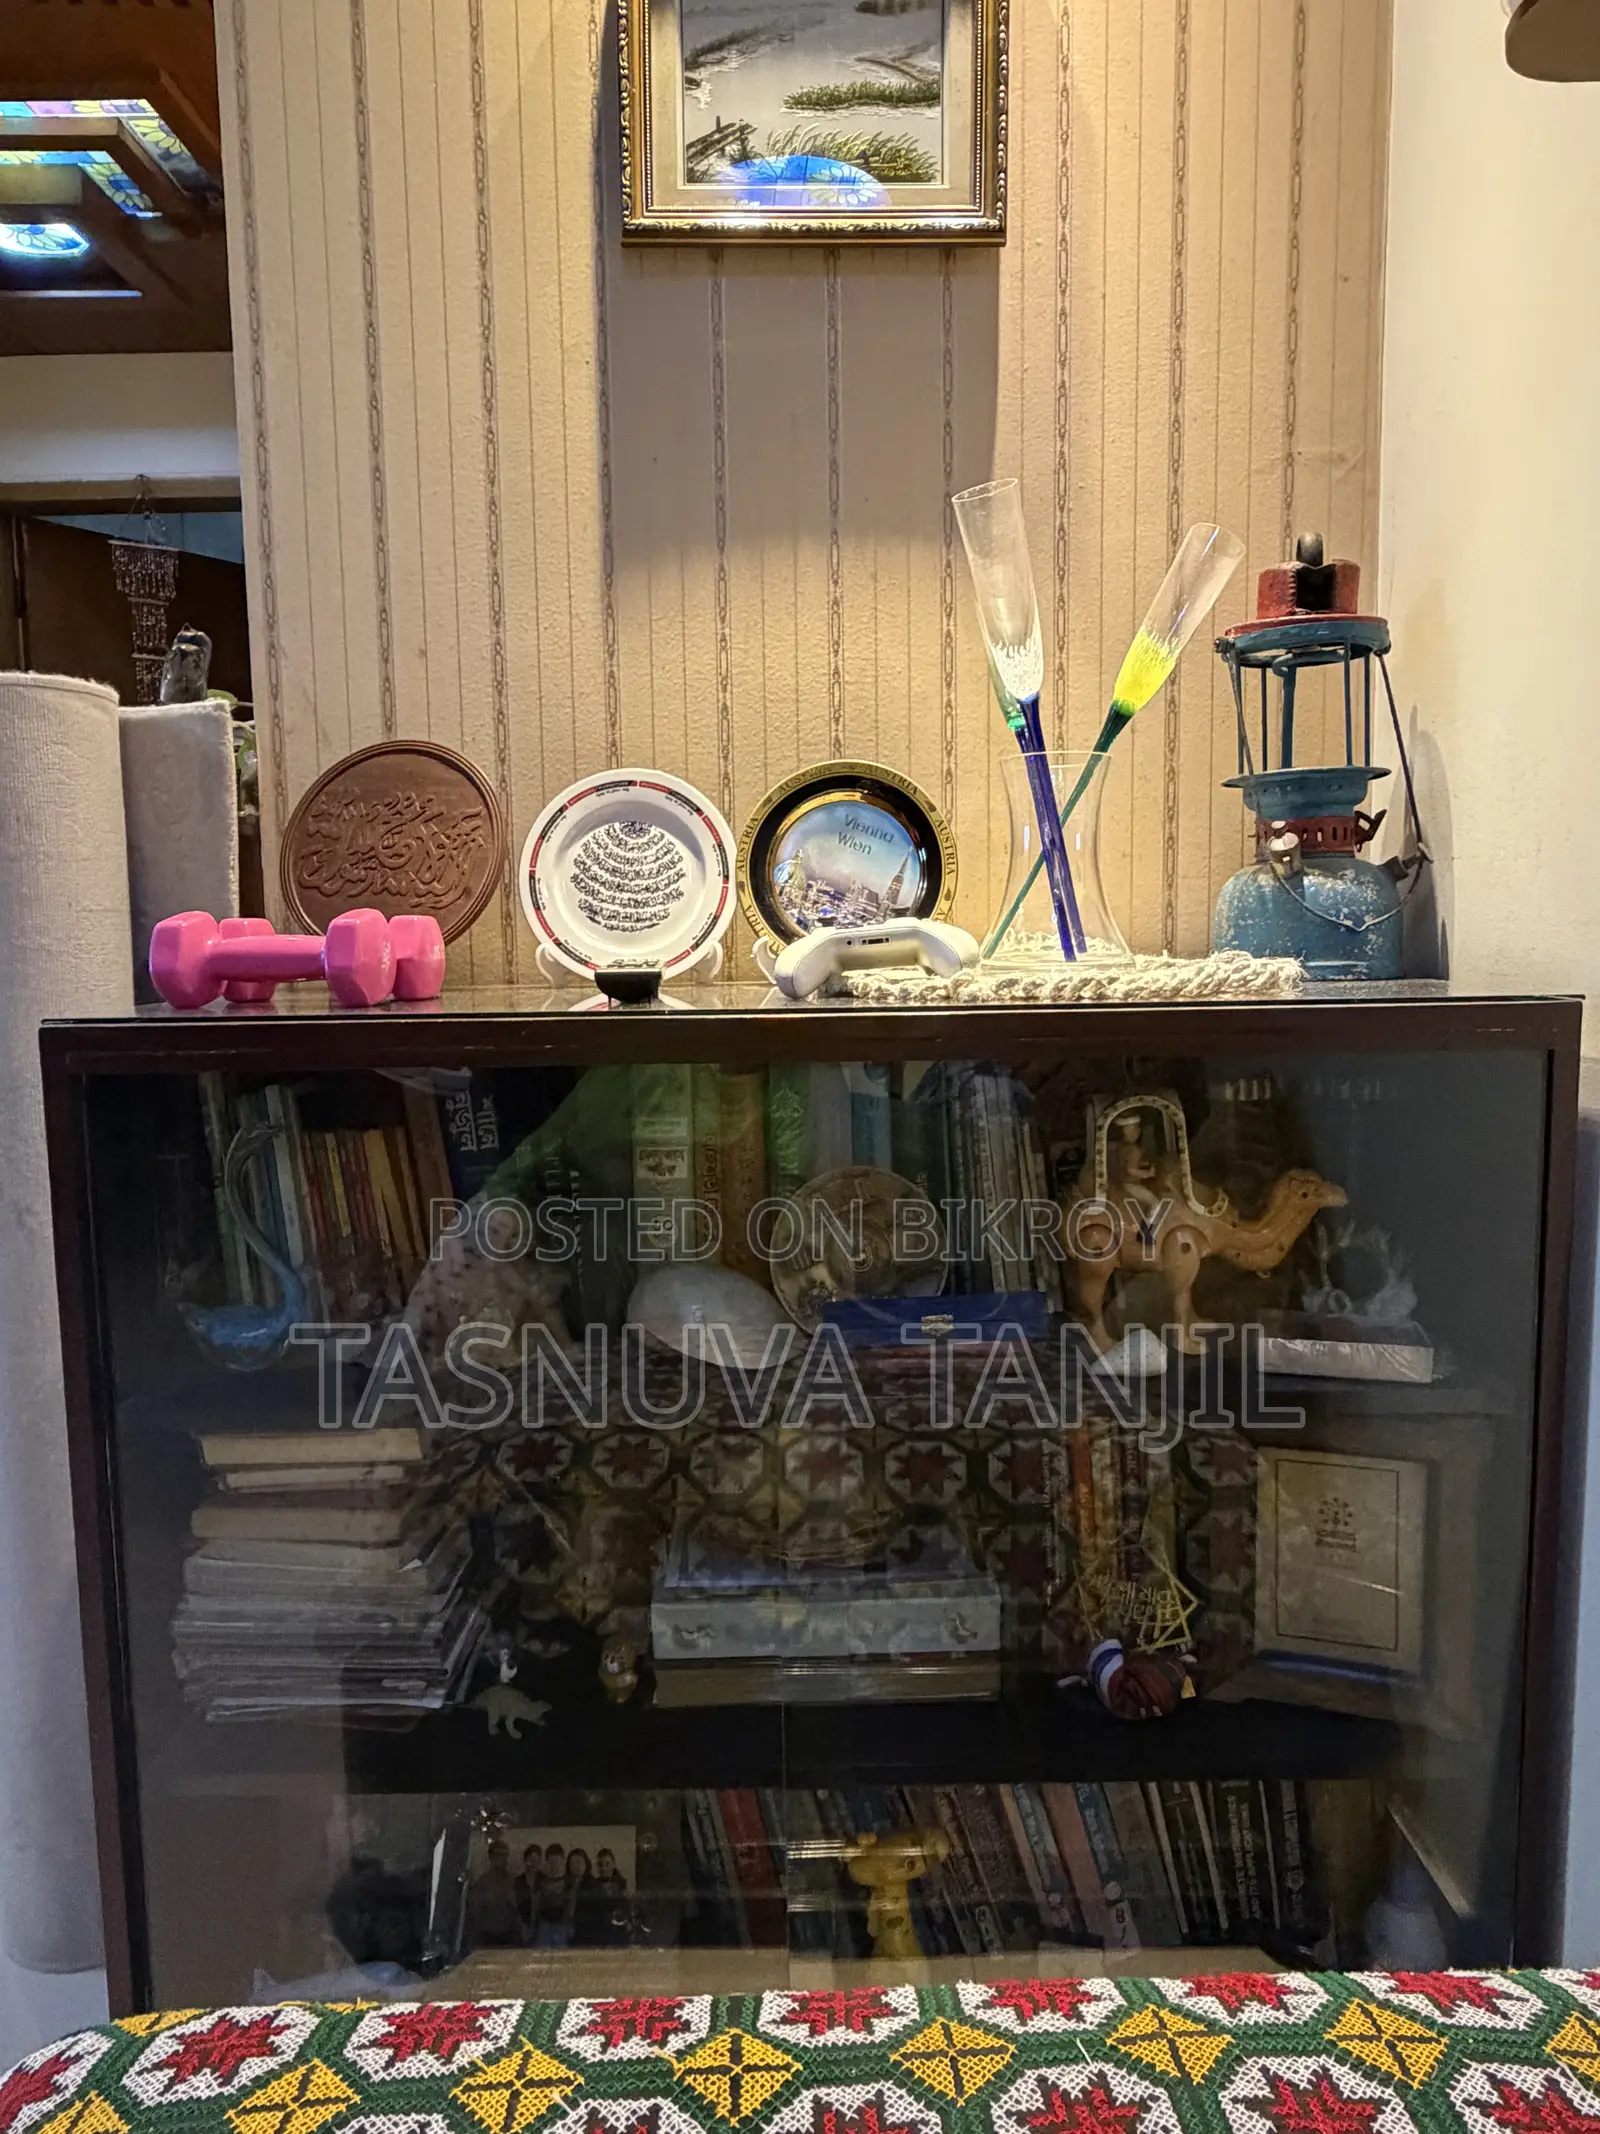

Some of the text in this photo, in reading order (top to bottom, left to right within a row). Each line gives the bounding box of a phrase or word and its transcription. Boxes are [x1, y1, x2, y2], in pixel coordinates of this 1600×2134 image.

[736, 818, 759, 873] AUSTRIA
[838, 831, 872, 855] Wien
[844, 812, 895, 843] Vienna
[935, 819, 956, 875] AUSTRIA
[744, 904, 786, 957] AUTRIA
